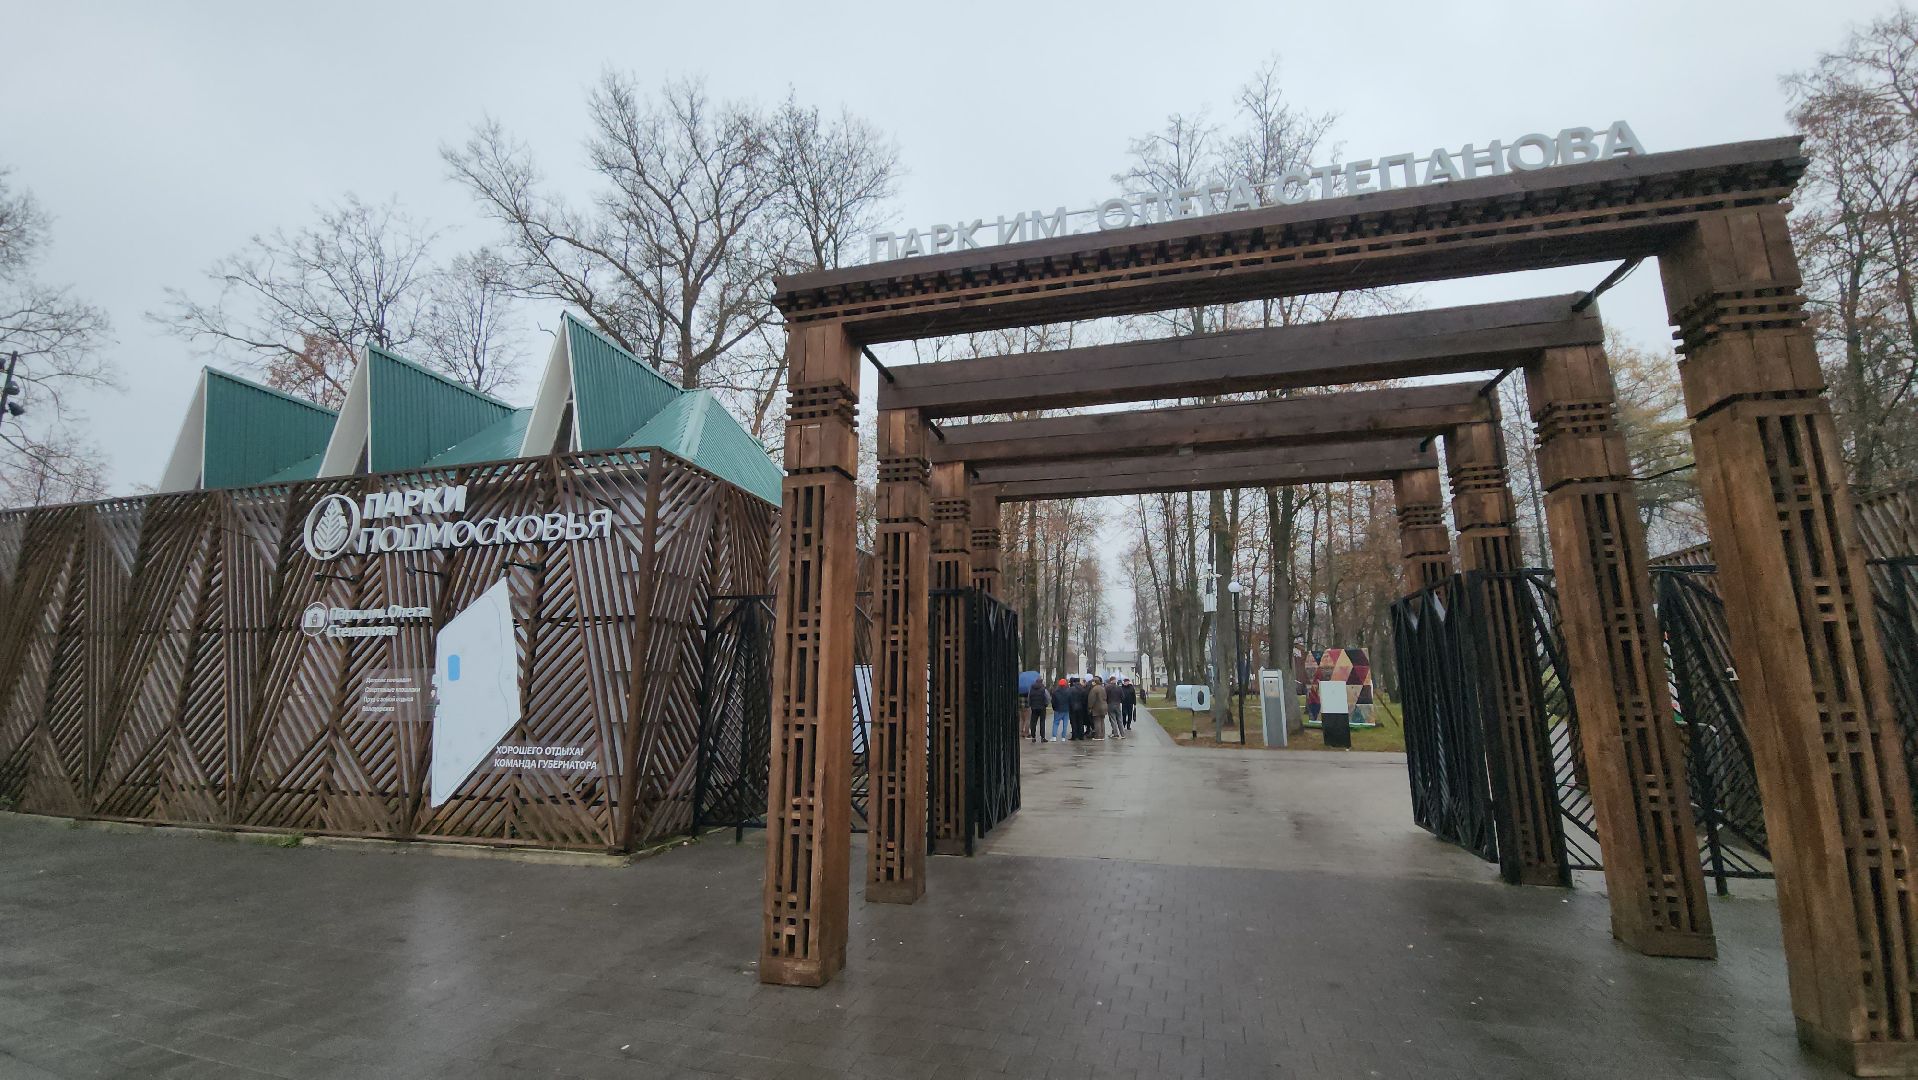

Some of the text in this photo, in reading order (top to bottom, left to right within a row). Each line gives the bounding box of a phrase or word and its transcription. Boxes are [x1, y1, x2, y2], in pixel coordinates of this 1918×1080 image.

[869, 119, 1647, 264] ПАРК ИМ. ОЛЕГА СТЕПАНОВА
[363, 485, 468, 519] ПАРКИ
[358, 509, 613, 554] ПОДМОСКОВЬЯ
[494, 758, 597, 770] КОМАНДА ГУБЕРНАТОРА
[495, 745, 584, 757] ХОРОШЕГО ОТДЫХА!
